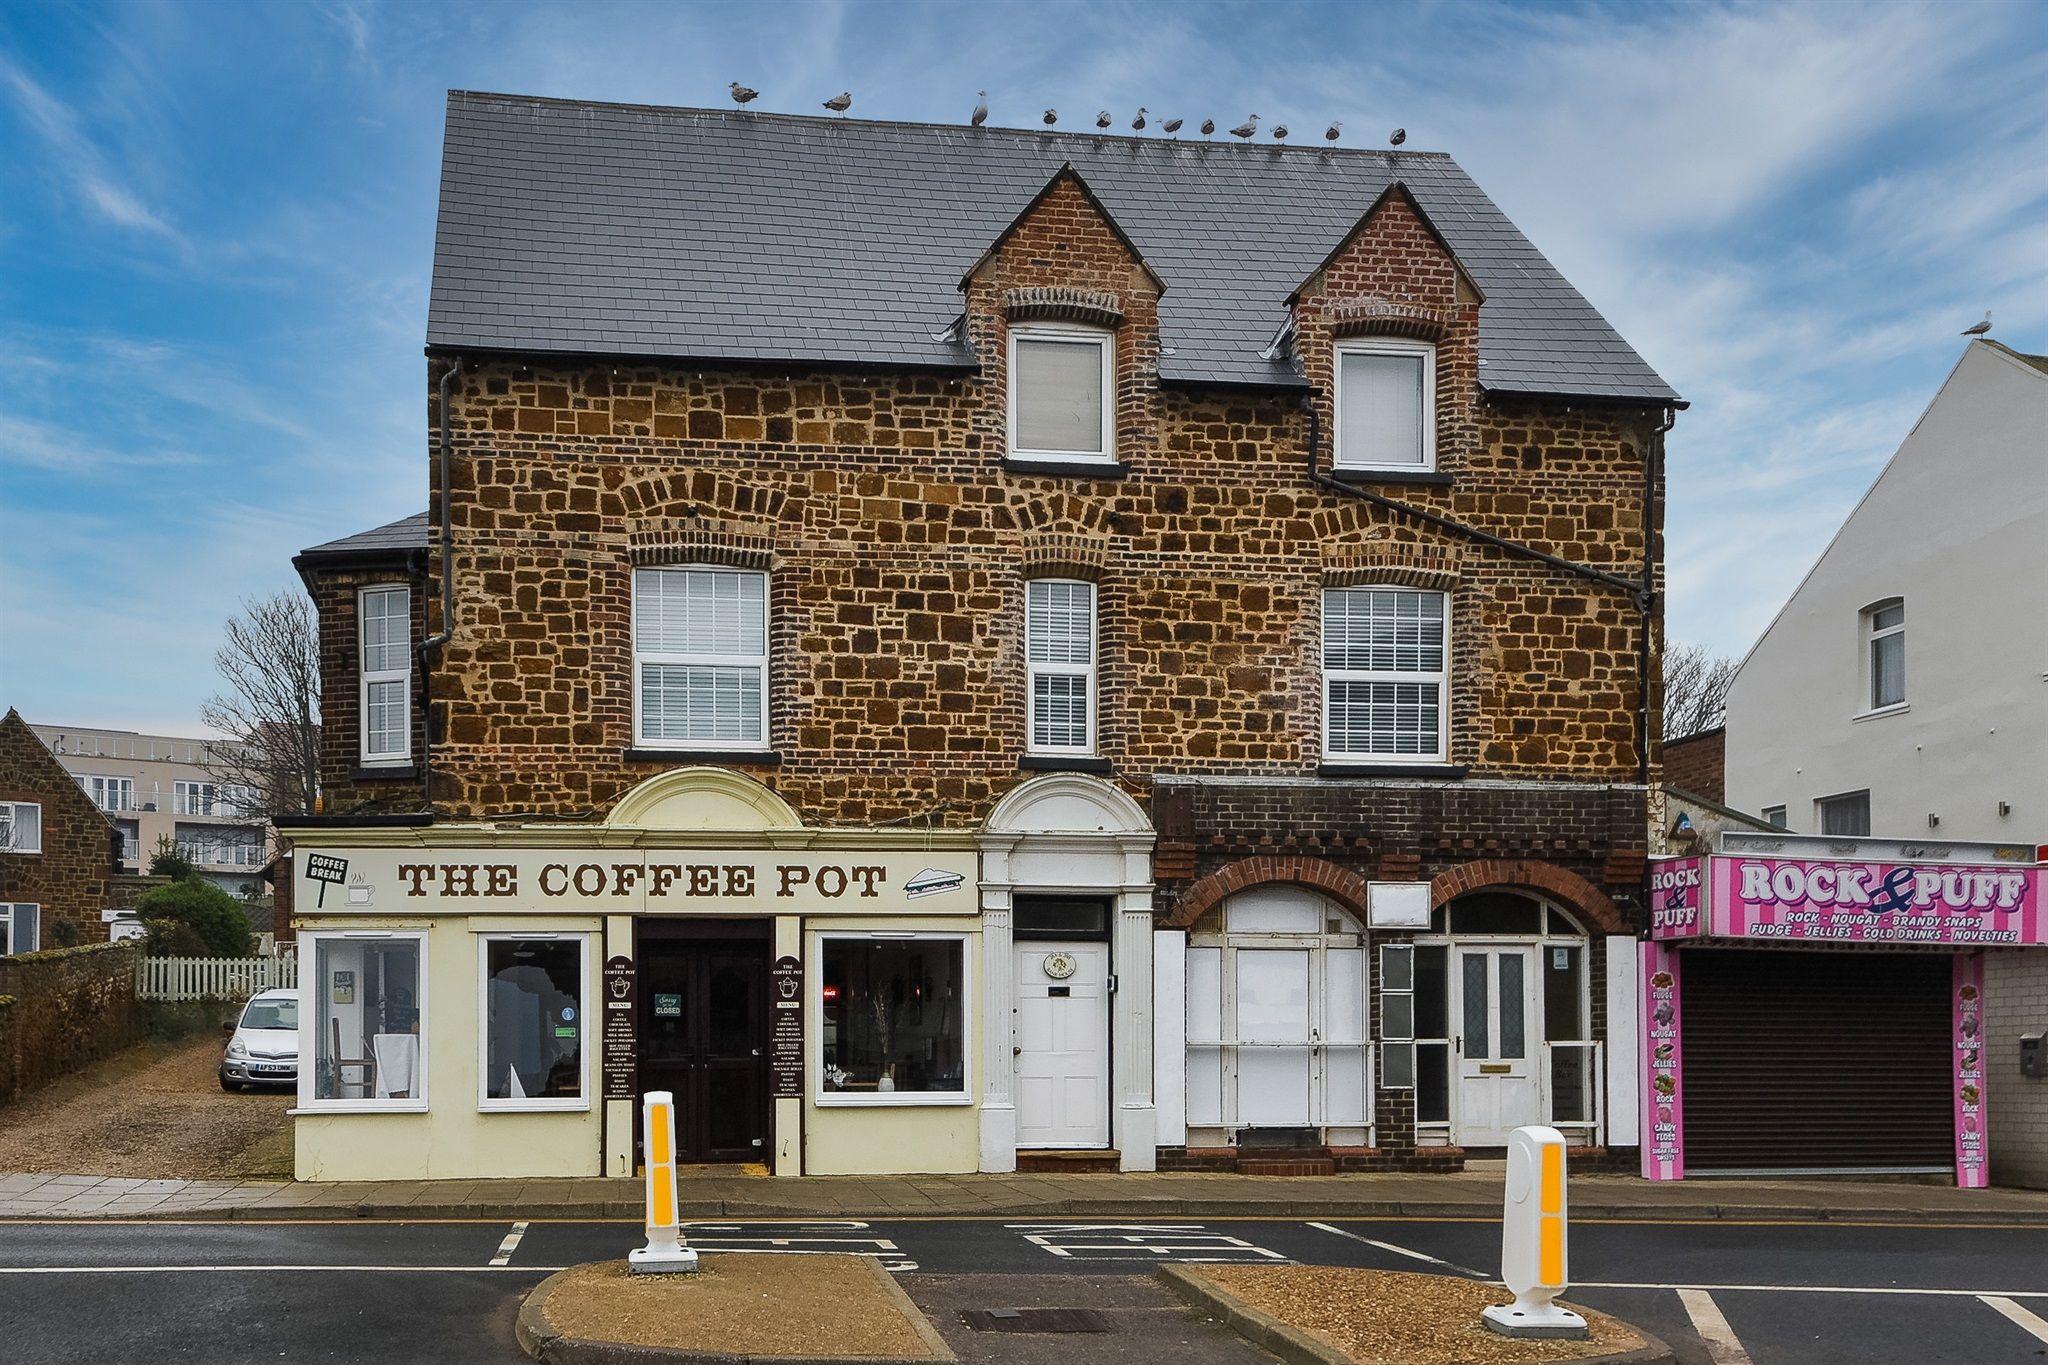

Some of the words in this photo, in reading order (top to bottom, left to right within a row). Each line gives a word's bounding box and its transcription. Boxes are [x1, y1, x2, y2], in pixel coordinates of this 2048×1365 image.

[311, 856, 346, 870] COFFEE
[311, 867, 343, 880] BREAK
[397, 863, 519, 897] THE
[537, 863, 755, 898] COFFEE
[775, 864, 887, 898] POT
[1651, 868, 1699, 890] ROCK
[1739, 863, 1872, 906] ROCK
[1868, 867, 1915, 914] &
[1913, 870, 2026, 910] PUFF
[1665, 886, 1686, 909] &
[1653, 906, 1696, 927] PUFF
[1786, 912, 1820, 923] ROCK
[1830, 914, 1881, 926] NOUGAT
[1892, 915, 1942, 927] BRANDY
[1943, 917, 1983, 928] SNAPS
[1750, 924, 1792, 936] FUDGE
[1804, 926, 1852, 938] JELLIES
[1863, 928, 1895, 939] COLD
[1898, 929, 1942, 940] DRINKS
[1953, 930, 2017, 942] NOVELTIES
[1652, 991, 1673, 999] FUDGE
[1650, 1030, 1677, 1038] NOUGAT
[1652, 1060, 1677, 1068] JELLIES
[1655, 1095, 1674, 1103] ROCK
[1654, 1124, 1677, 1132] CANDY
[1656, 1133, 1676, 1141] FLOSS
